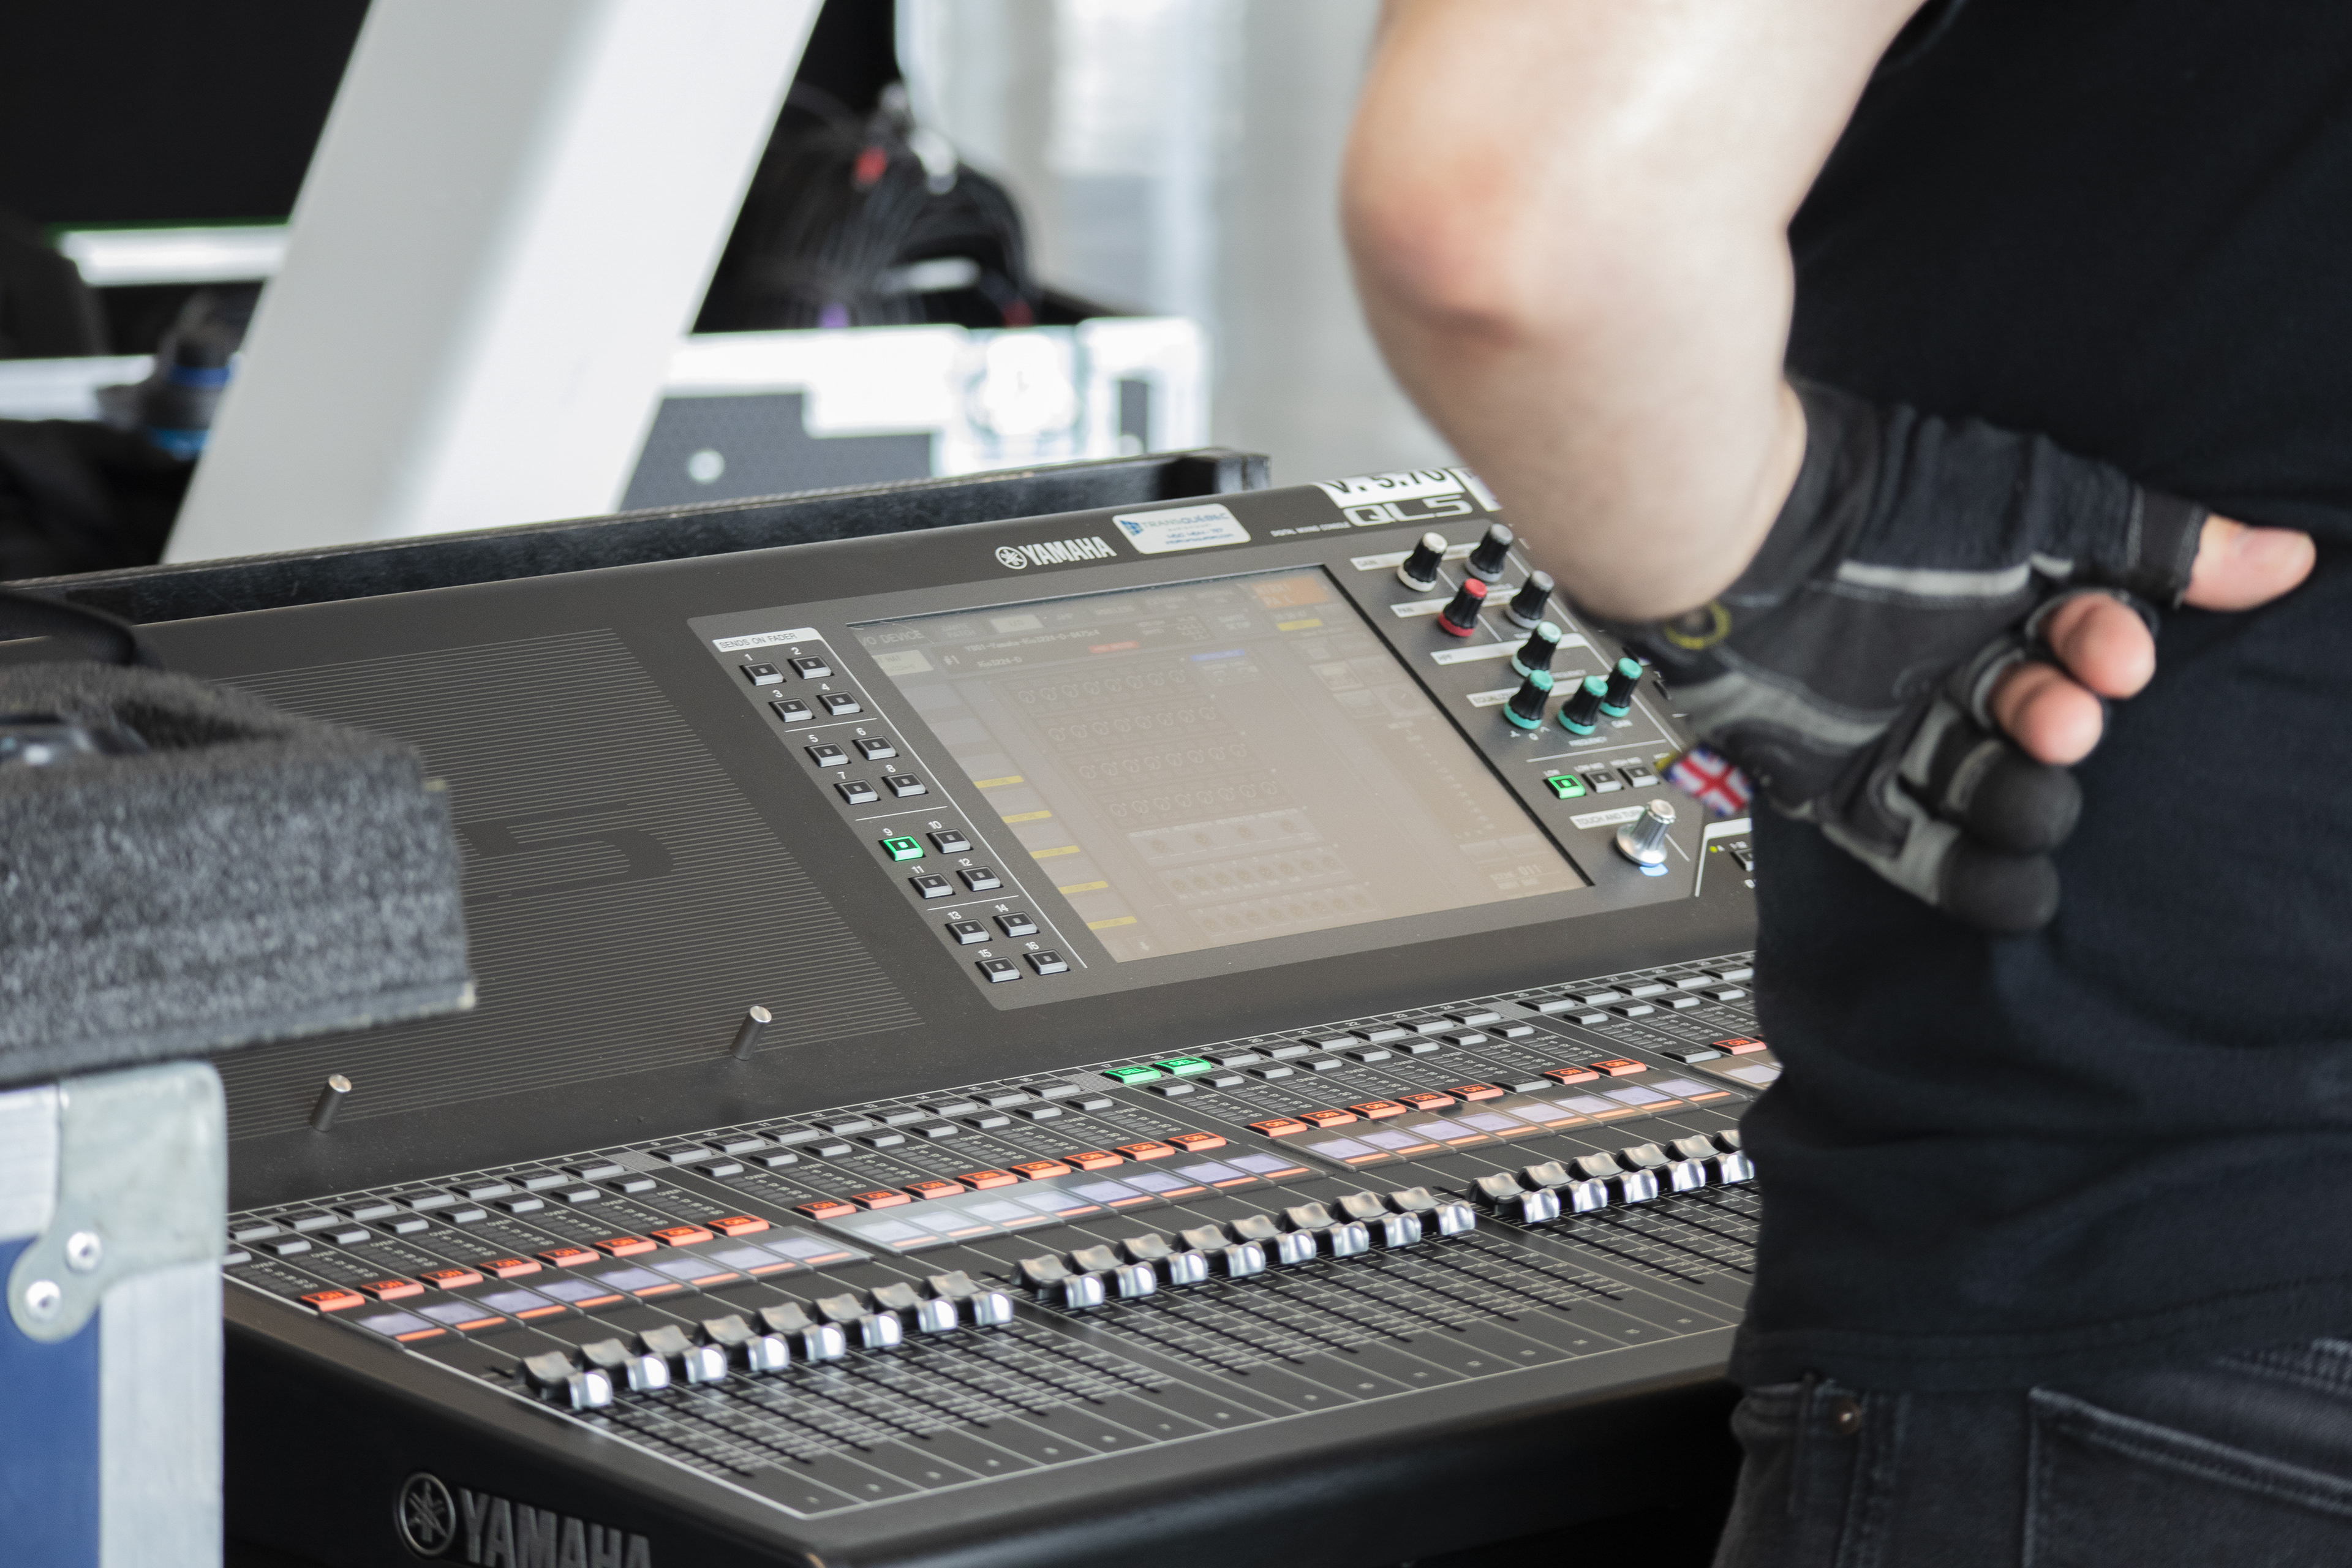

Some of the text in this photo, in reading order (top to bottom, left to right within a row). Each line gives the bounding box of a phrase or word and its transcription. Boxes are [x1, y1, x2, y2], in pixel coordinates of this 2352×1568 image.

[1343, 494, 1474, 527] QL5
[1295, 525, 1321, 533] MIXING
[1319, 521, 1352, 531] CONSOLE
[1018, 536, 1118, 566] YAMAHA
[720, 632, 798, 649] SENDS ON FADER
[880, 630, 925, 643] DEVICE
[791, 647, 802, 655] 2
[744, 653, 753, 662] 1
[772, 690, 783, 698] 3
[856, 727, 867, 736] 6
[808, 734, 819, 743] 5
[885, 764, 896, 773] 8
[837, 771, 846, 780] 7
[1576, 815, 1604, 825] TOUCH
[1605, 813, 1621, 821] AND
[928, 820, 943, 829] 10
[883, 828, 894, 837] 9
[958, 858, 973, 867] 12
[911, 865, 925, 874] 11
[995, 903, 1009, 913] 14
[947, 911, 962, 920] 13
[1025, 941, 1040, 951] 16
[978, 949, 993, 958] 15
[1118, 1067, 1147, 1076] SEL
[744, 1172, 771, 1181] OVER
[867, 1191, 893, 1199] ON
[812, 1200, 839, 1209] ON
[723, 1218, 752, 1226] ON
[667, 1227, 695, 1236] ON
[612, 1238, 639, 1246] ON
[459, 1487, 651, 1568] YAMAHA
